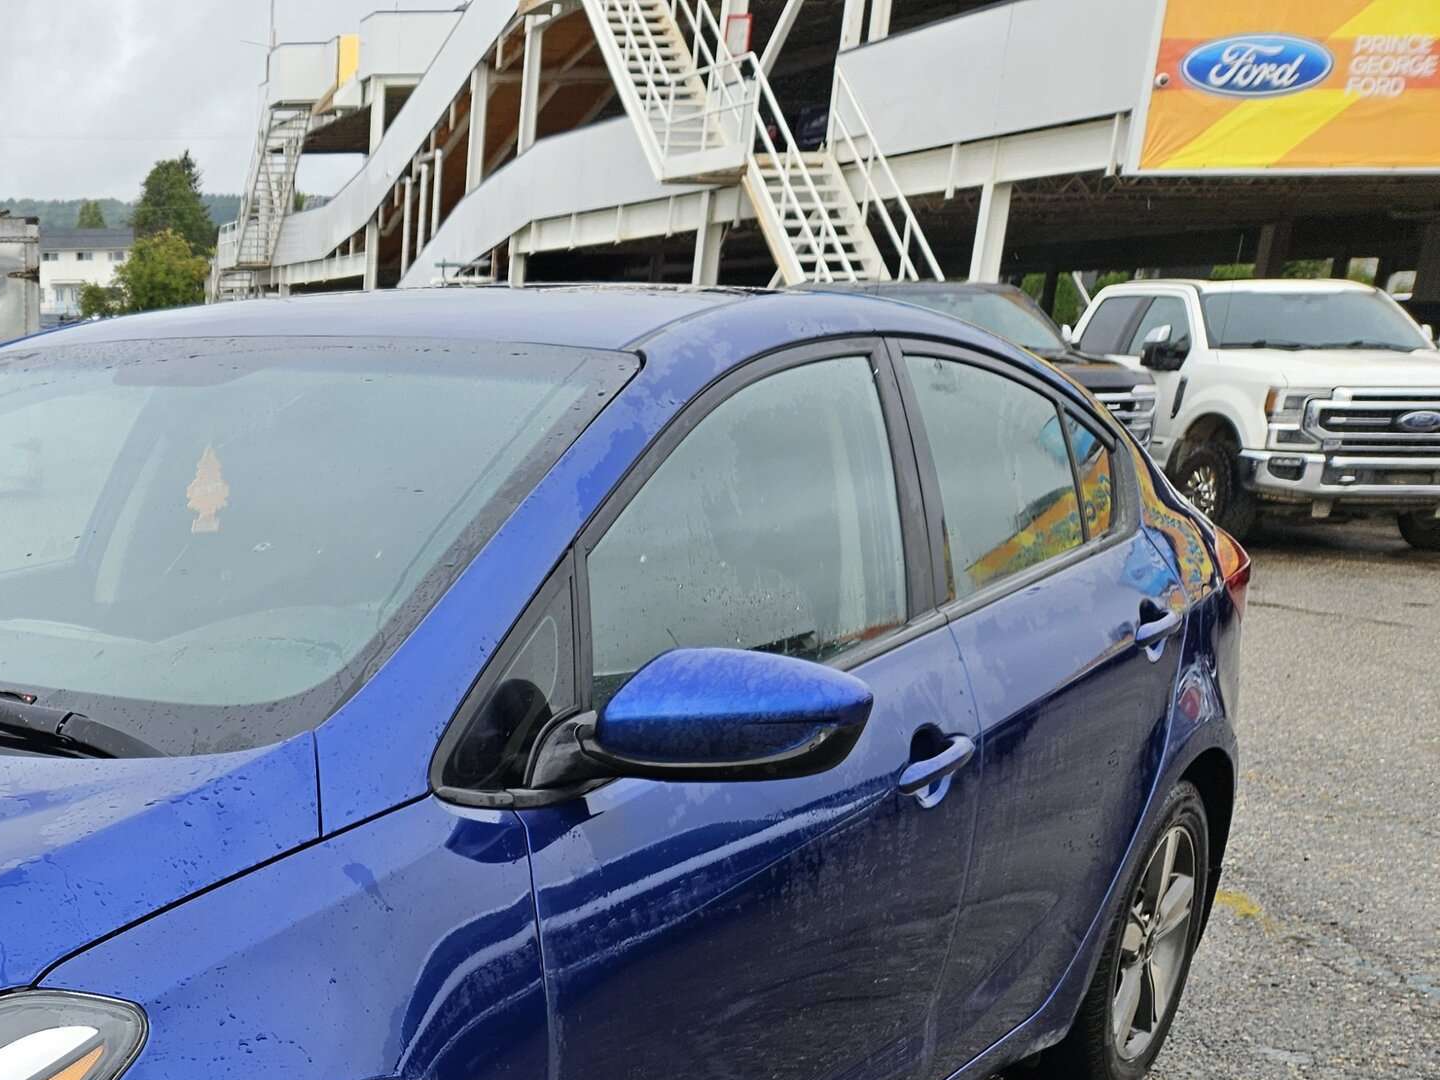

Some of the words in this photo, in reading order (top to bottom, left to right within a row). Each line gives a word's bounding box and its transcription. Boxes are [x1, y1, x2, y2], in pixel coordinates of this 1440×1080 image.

[1353, 35, 1435, 55] PRINCE
[1208, 43, 1306, 88] Ford
[1350, 55, 1439, 77] GEORGE
[1344, 76, 1406, 97] FORD
